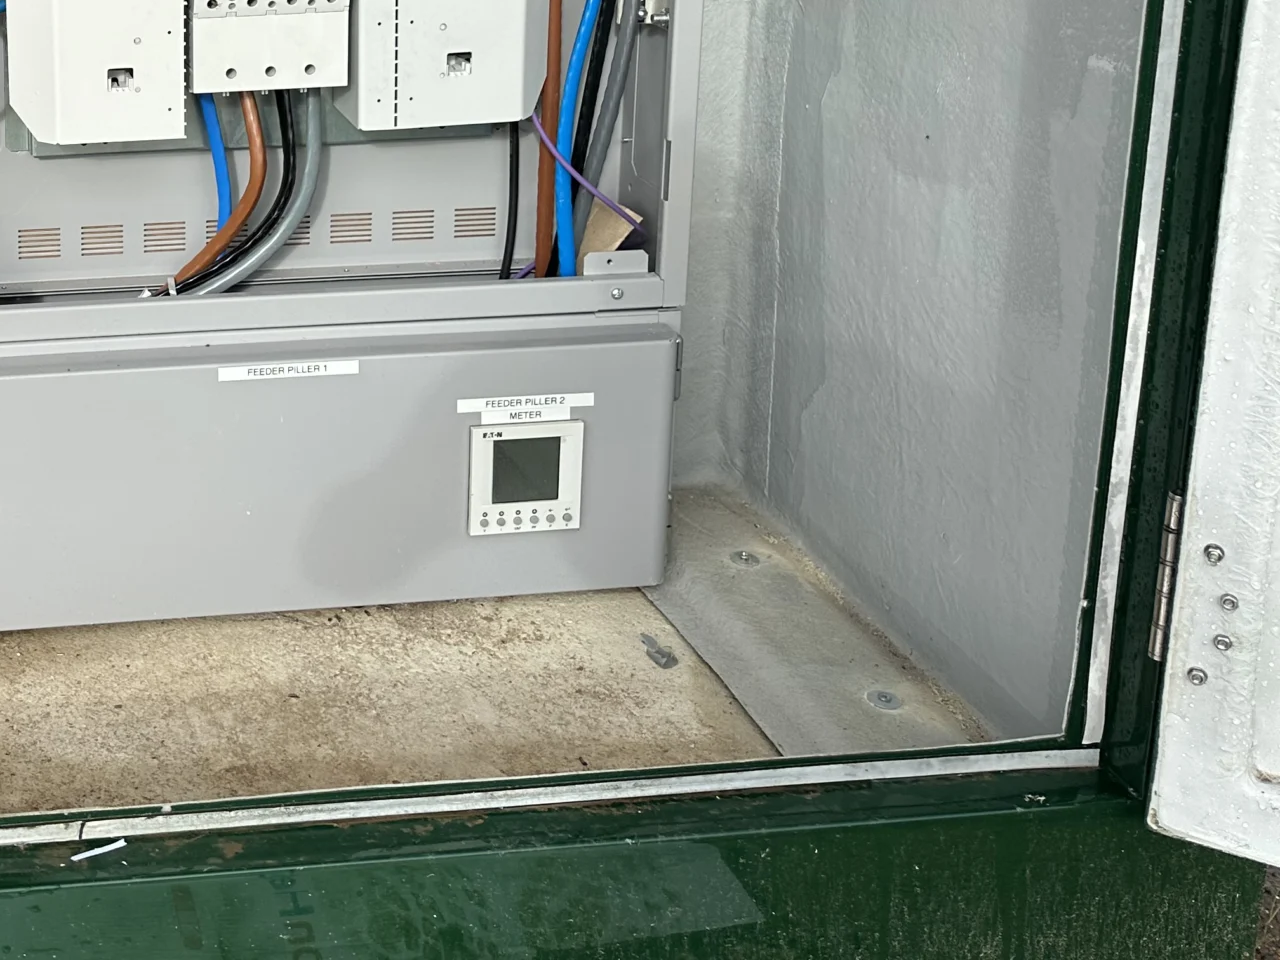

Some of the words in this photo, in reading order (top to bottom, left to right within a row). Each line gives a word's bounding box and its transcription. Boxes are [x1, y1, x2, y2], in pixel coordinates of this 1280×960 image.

[247, 367, 285, 376] FEEDER
[287, 365, 320, 374] PILLER
[485, 399, 522, 408] FEEDER
[525, 397, 557, 406] PILLER
[559, 396, 565, 404] 2
[510, 411, 542, 419] METER
